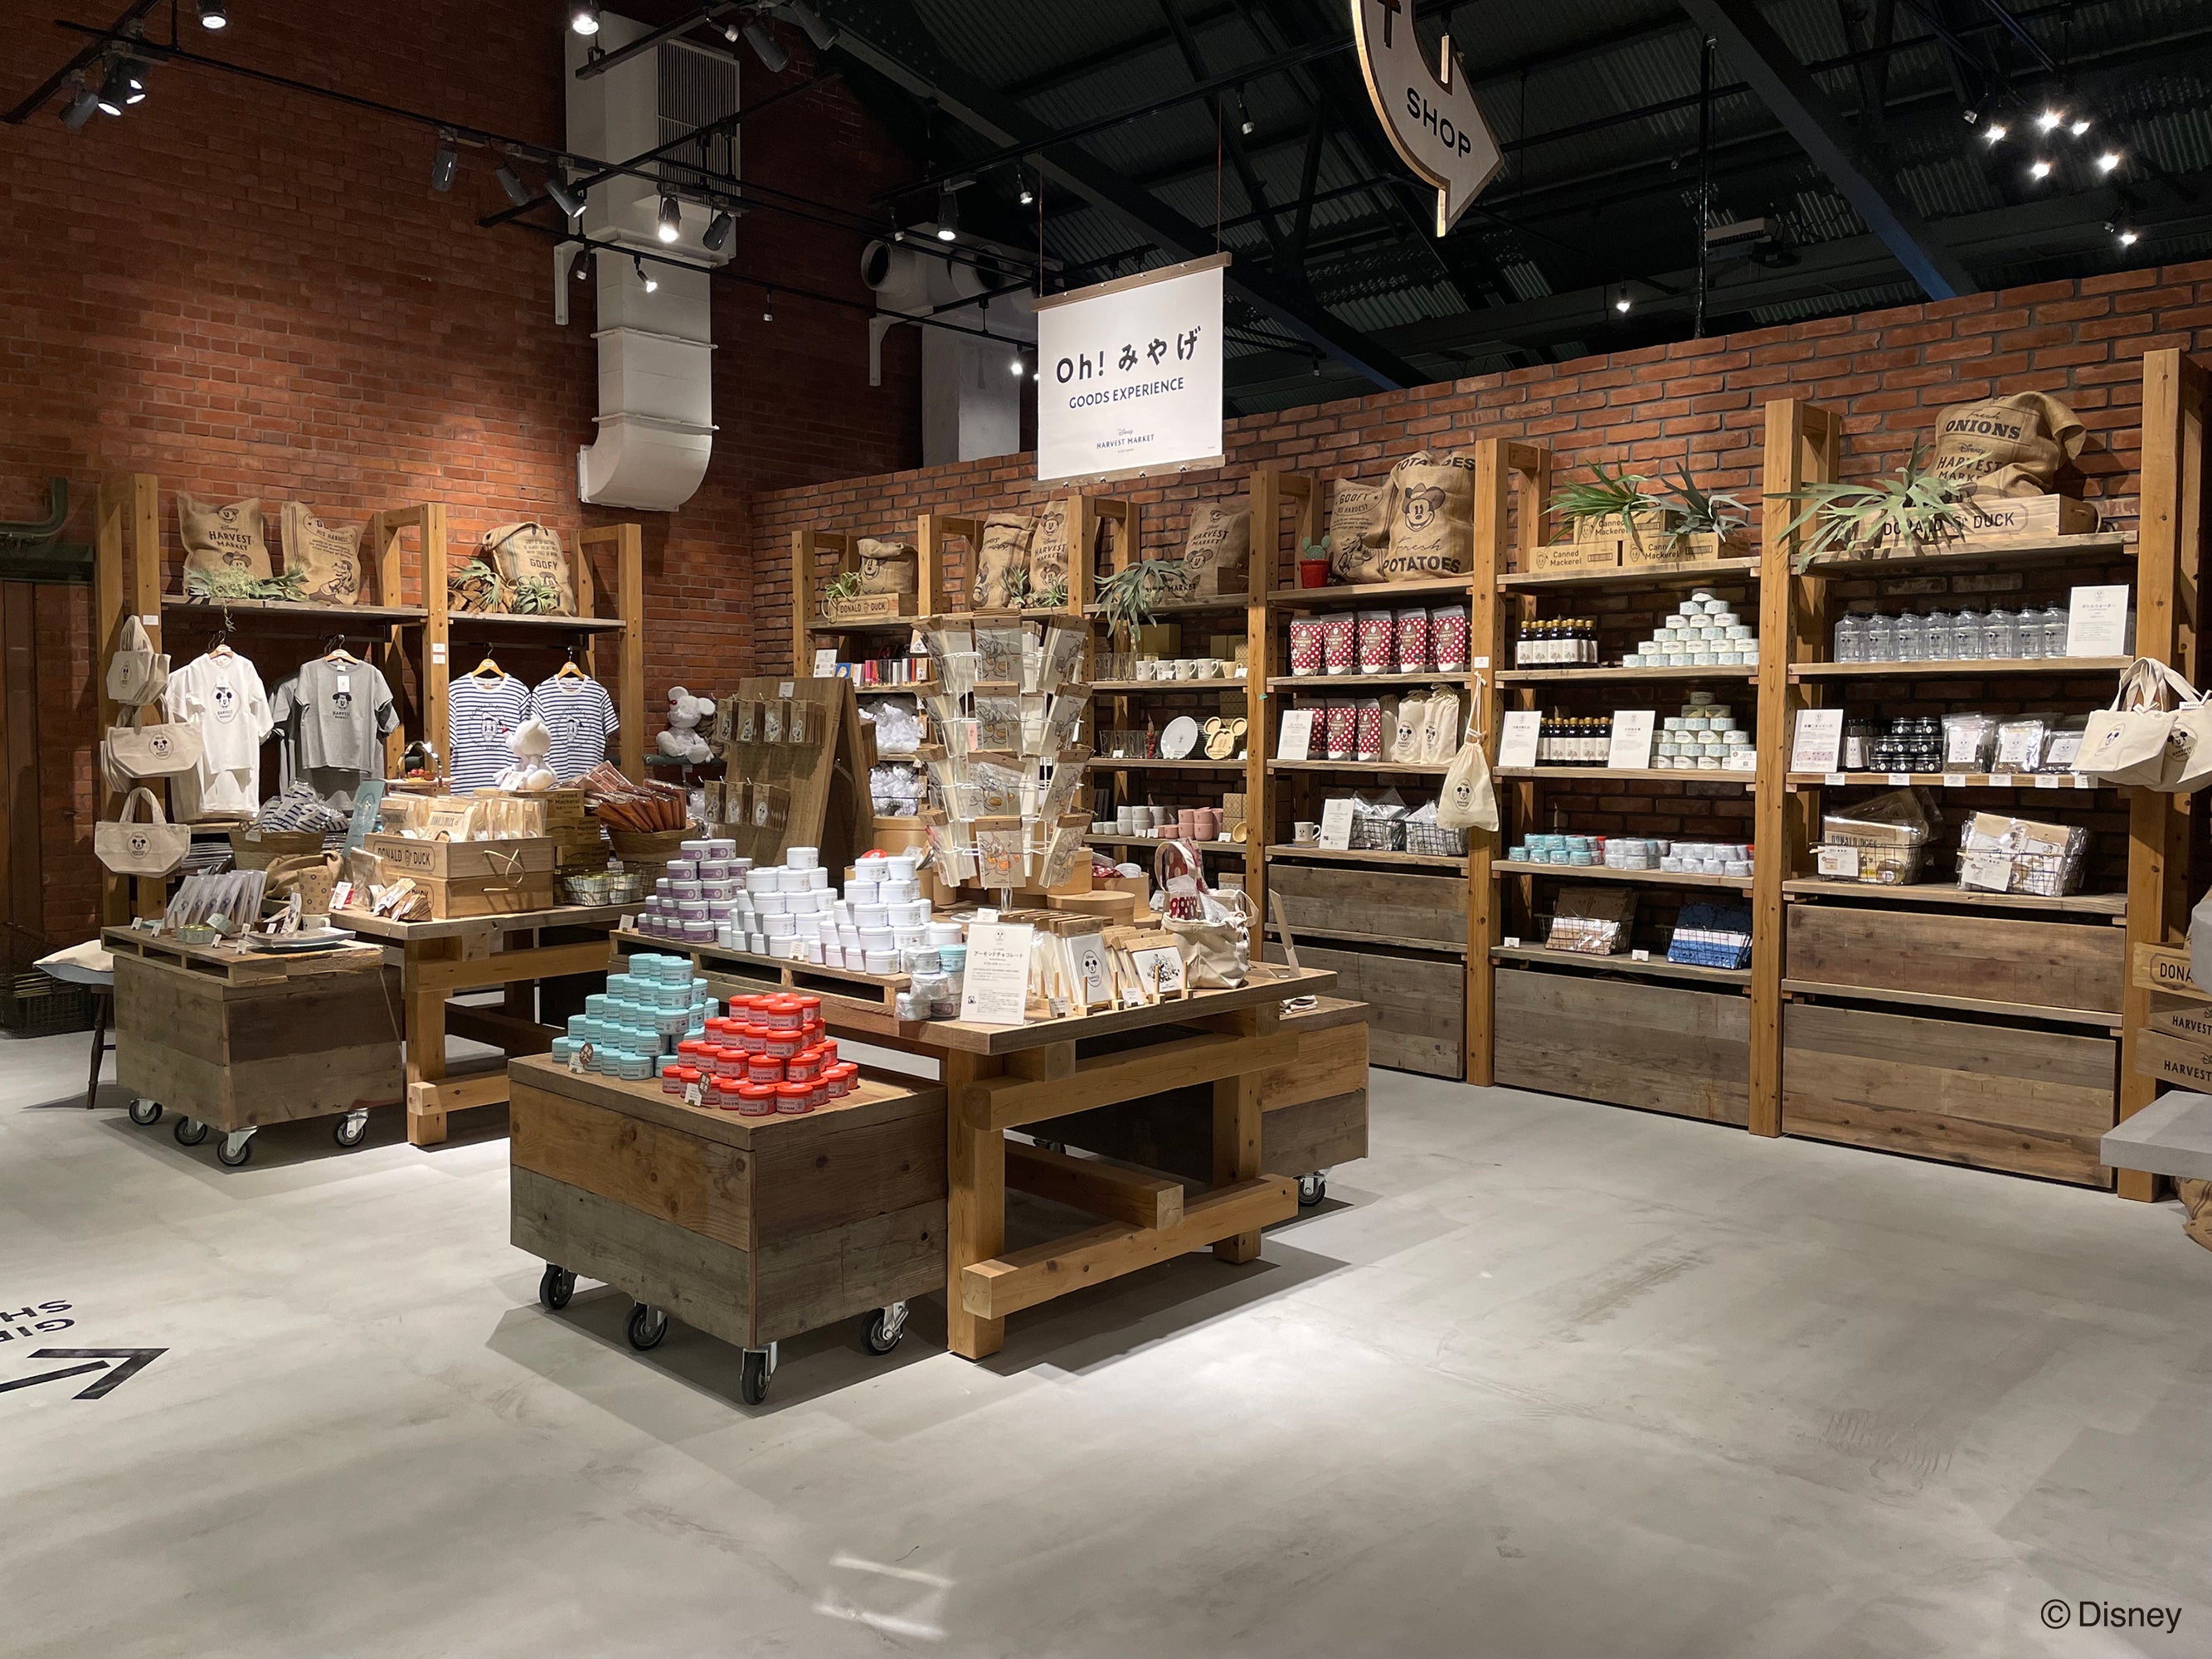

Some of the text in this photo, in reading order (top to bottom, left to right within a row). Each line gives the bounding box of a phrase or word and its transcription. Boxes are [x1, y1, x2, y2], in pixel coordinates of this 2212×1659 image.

[1407, 87, 1471, 158] SHOP
[1056, 325, 1202, 383] Oh! みやげ
[1069, 377, 1184, 409] GOODS EXPERIENCE
[1945, 419, 2021, 440] ONIONS
[1096, 433, 1155, 450] HARVEST MARKET
[1958, 442, 1986, 455] Disney
[1973, 512, 2015, 529] DUCK
[209, 531, 252, 545] HARVEST
[1191, 529, 1229, 542] HARVEST
[1035, 543, 1067, 557] HARVEST
[1553, 550, 1579, 558] Canned
[1644, 550, 1680, 560] Mackerel
[530, 558, 558, 570] GOOFY
[1037, 552, 1061, 563] MARKET
[1383, 556, 1461, 573] POTATOES
[1549, 557, 1582, 567] Mackerel
[840, 602, 885, 613] DONALD DUCK
[378, 848, 431, 866] DONALD DUCK
[974, 951, 1024, 959] アーモンドチョコレート
[2172, 1015, 2212, 1037] HARVEST
[2164, 1060, 2212, 1082] HARVEST
